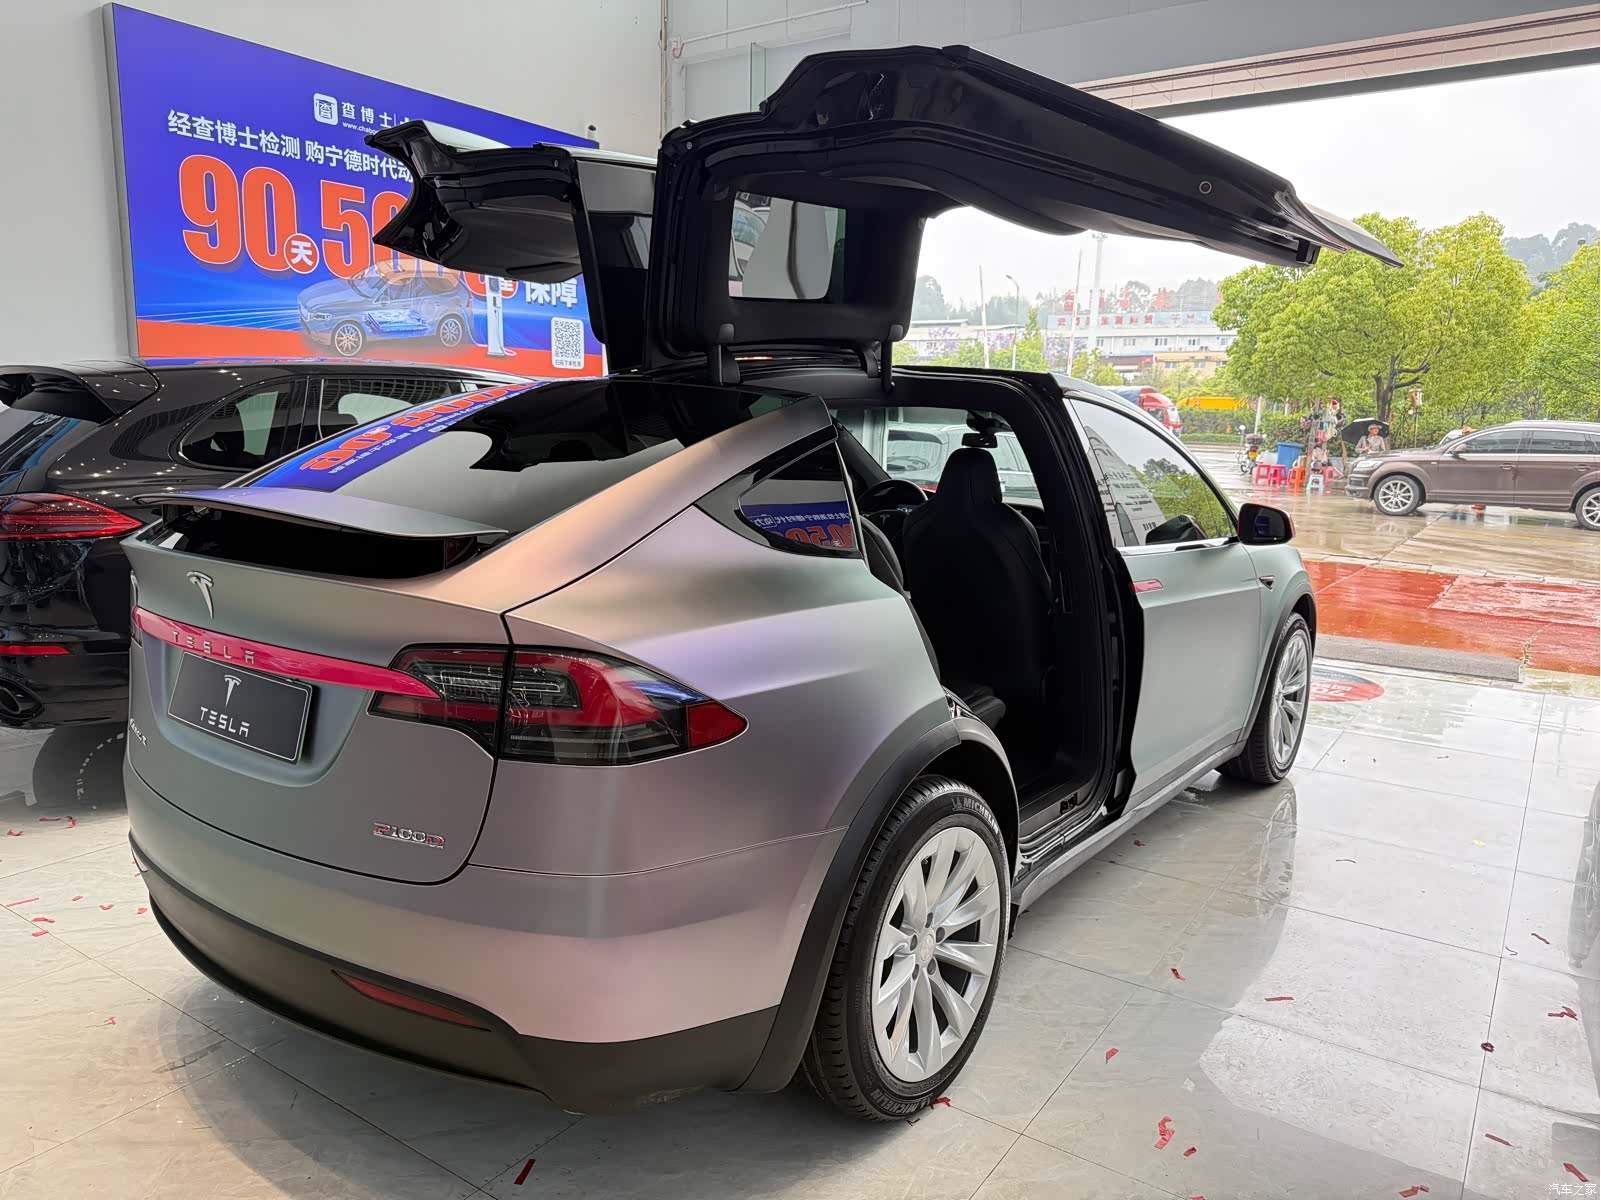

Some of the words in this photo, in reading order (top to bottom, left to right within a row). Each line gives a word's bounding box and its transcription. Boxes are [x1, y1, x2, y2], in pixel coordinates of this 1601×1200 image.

[341, 101, 393, 129] 查博士
[167, 109, 300, 160] 经查博士检测
[179, 154, 298, 271] 90
[291, 239, 314, 267] 天
[172, 630, 255, 665] TESLA
[200, 706, 250, 738] TESLA
[963, 797, 999, 834] MICHELIN
[373, 822, 444, 849] P100D
[870, 1088, 920, 1114] MICHELIN
